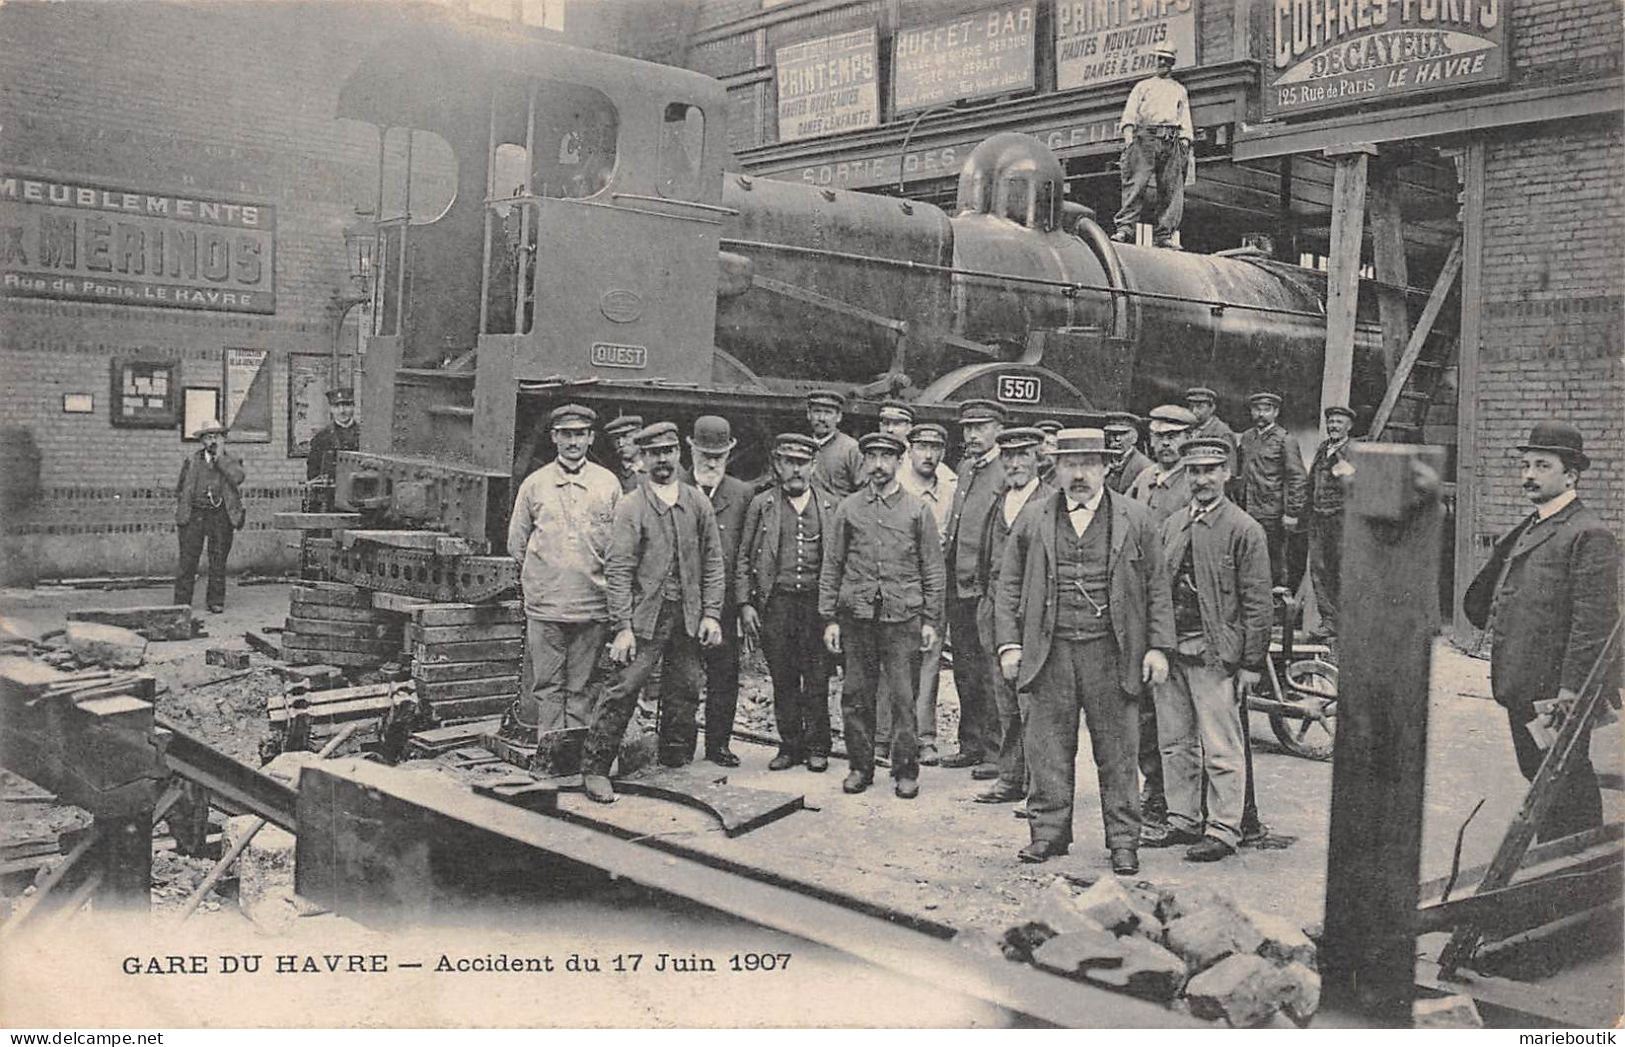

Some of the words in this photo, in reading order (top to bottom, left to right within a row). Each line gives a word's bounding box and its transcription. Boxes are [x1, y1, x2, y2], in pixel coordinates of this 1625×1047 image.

[1061, 37, 1098, 62] HAUTES
[1309, 31, 1451, 79] DECAYEUX
[779, 52, 874, 98] PRINTEMPS
[1083, 60, 1117, 80] DAMES
[1119, 59, 1129, 75] &
[1301, 85, 1324, 103] Rue
[1326, 82, 1338, 98] de
[1388, 67, 1407, 88] LE
[1415, 53, 1486, 83] HAVRE
[803, 159, 885, 185] SORTIE
[905, 148, 955, 172] DES
[4, 274, 45, 290] Rue
[53, 278, 76, 293] de
[145, 287, 167, 299] LE
[175, 290, 252, 306] HAVRE
[597, 346, 643, 364] OUEST
[1004, 379, 1035, 399] 550
